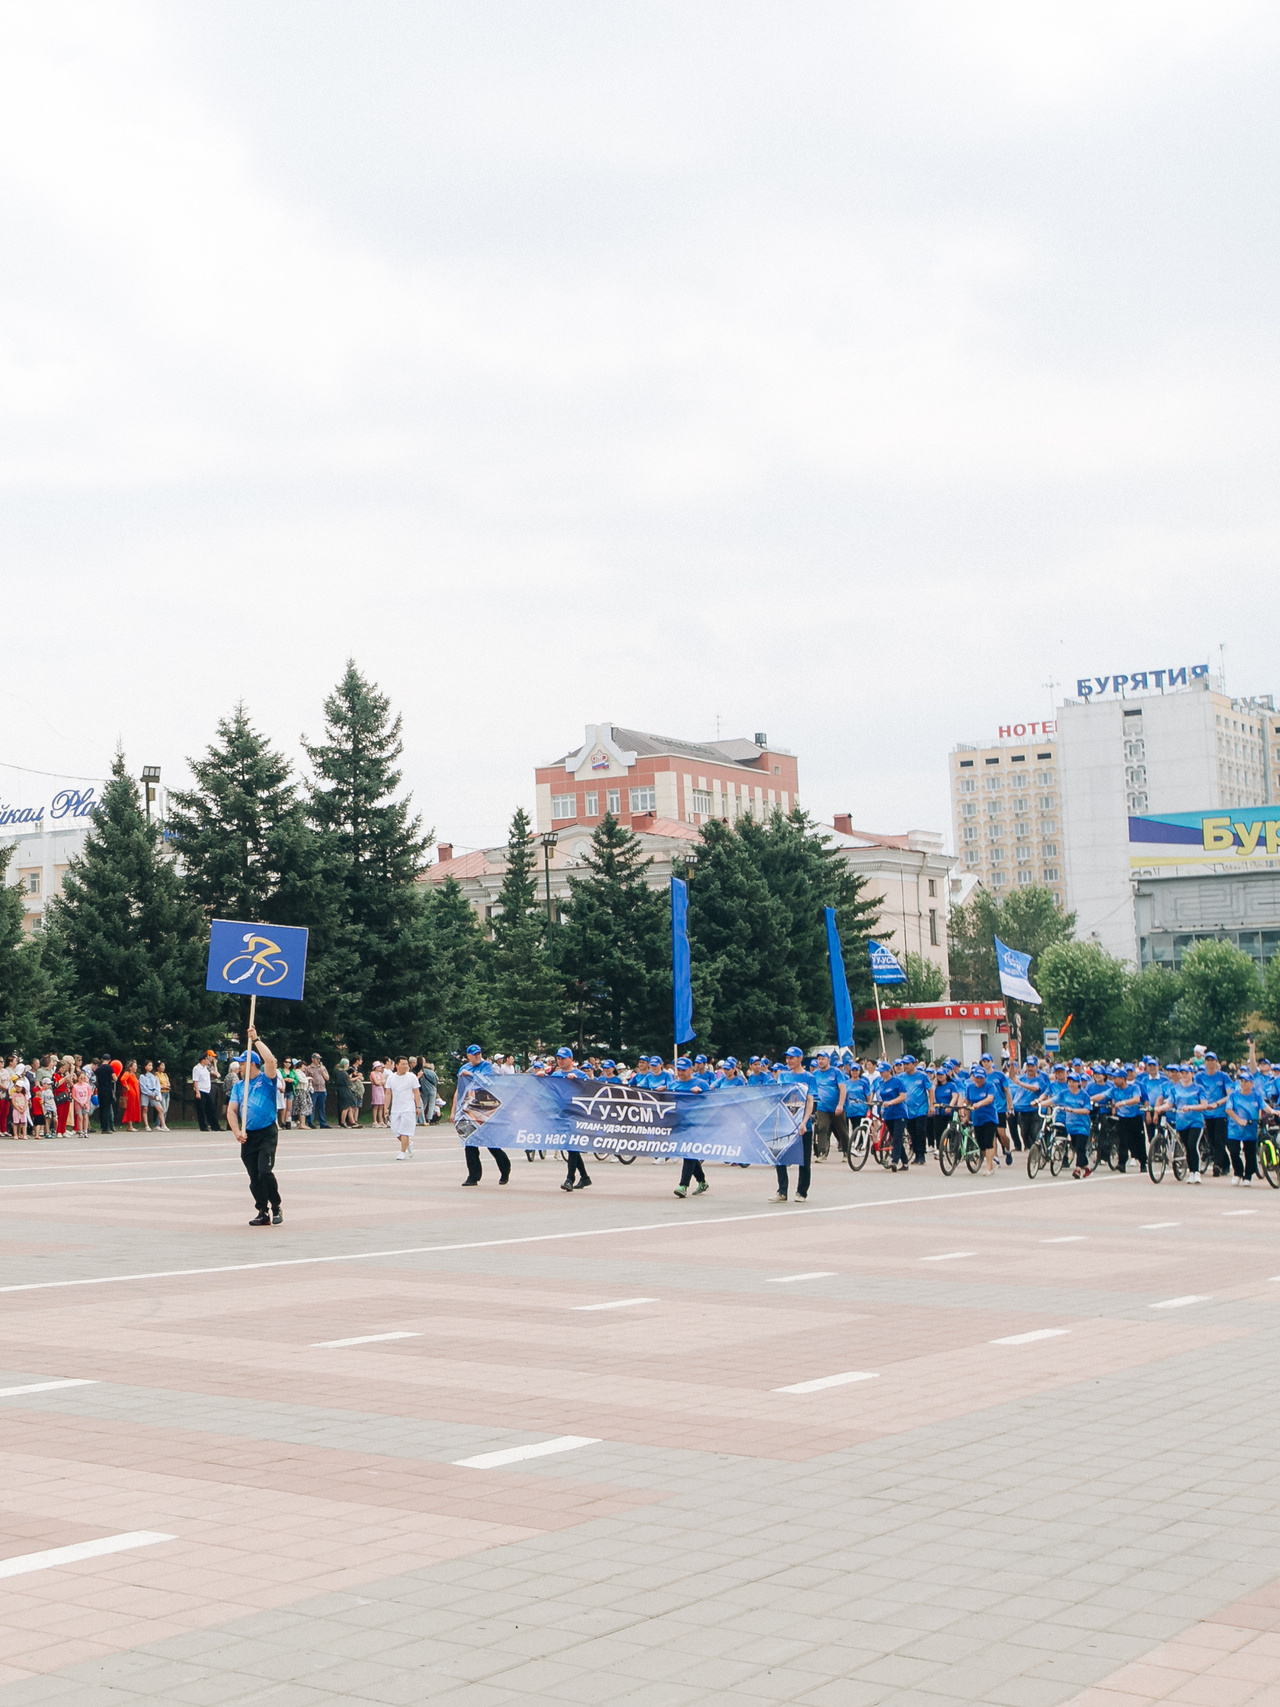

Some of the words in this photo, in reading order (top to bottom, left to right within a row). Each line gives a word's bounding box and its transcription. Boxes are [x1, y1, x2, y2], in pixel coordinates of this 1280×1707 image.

[1076, 664, 1209, 697] БУРЯТИЯ
[998, 720, 1057, 739] HOTE
[597, 1104, 654, 1123] У-УСМ
[575, 1121, 672, 1136] УЛАН-УДЭСТАЛЬМОСТ
[515, 1129, 542, 1145] Без
[545, 1132, 567, 1145] нас
[569, 1134, 589, 1147] не
[593, 1136, 678, 1153] строятся
[679, 1141, 742, 1157] мосты
